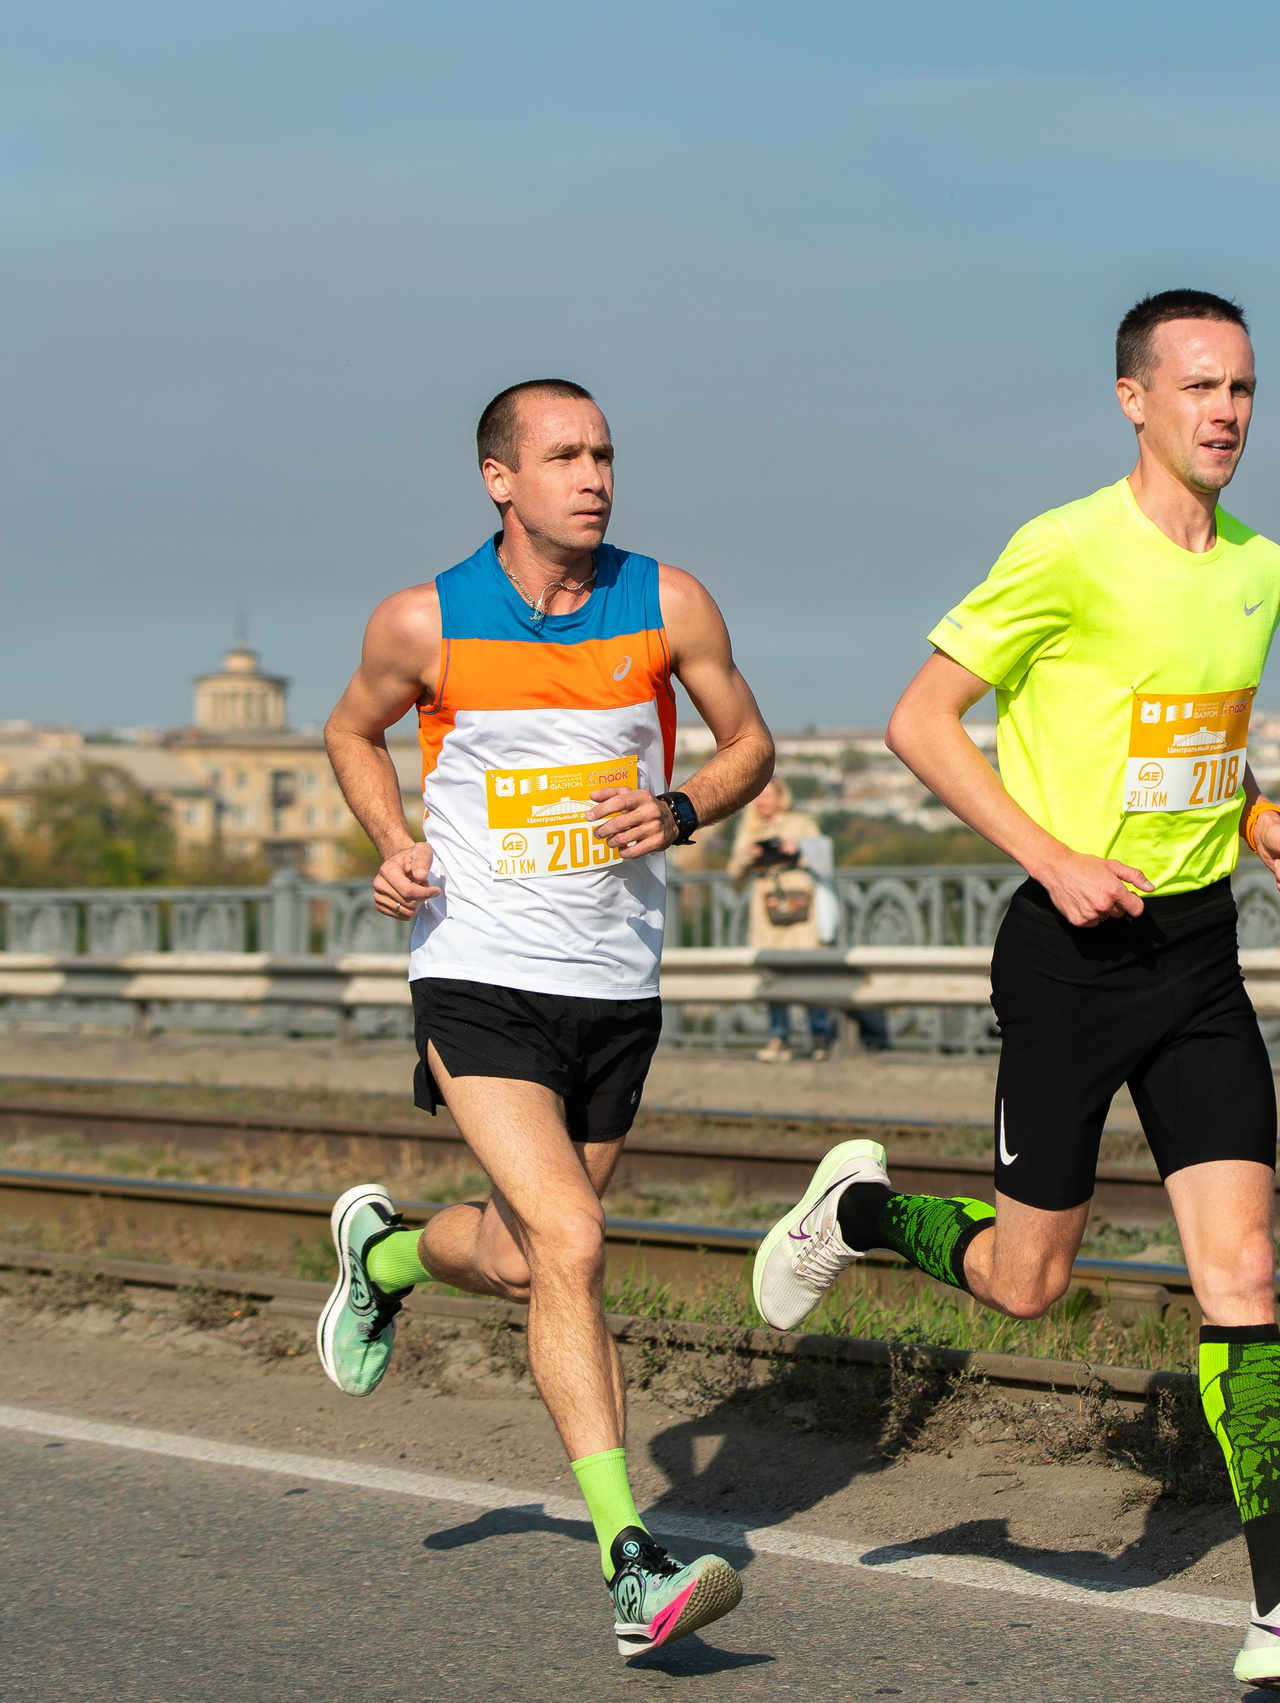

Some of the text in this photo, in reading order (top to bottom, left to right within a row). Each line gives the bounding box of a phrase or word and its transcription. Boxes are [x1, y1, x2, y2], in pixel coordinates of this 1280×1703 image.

[1193, 710, 1219, 719] ФАЭТОН
[549, 782, 583, 790] ФАЭТОН
[1188, 755, 1239, 805] 2118
[1130, 791, 1168, 807] 21,1 КМ
[526, 813, 579, 824] Центральный
[546, 826, 622, 872] 205
[497, 859, 536, 875] 21,1 КМ
